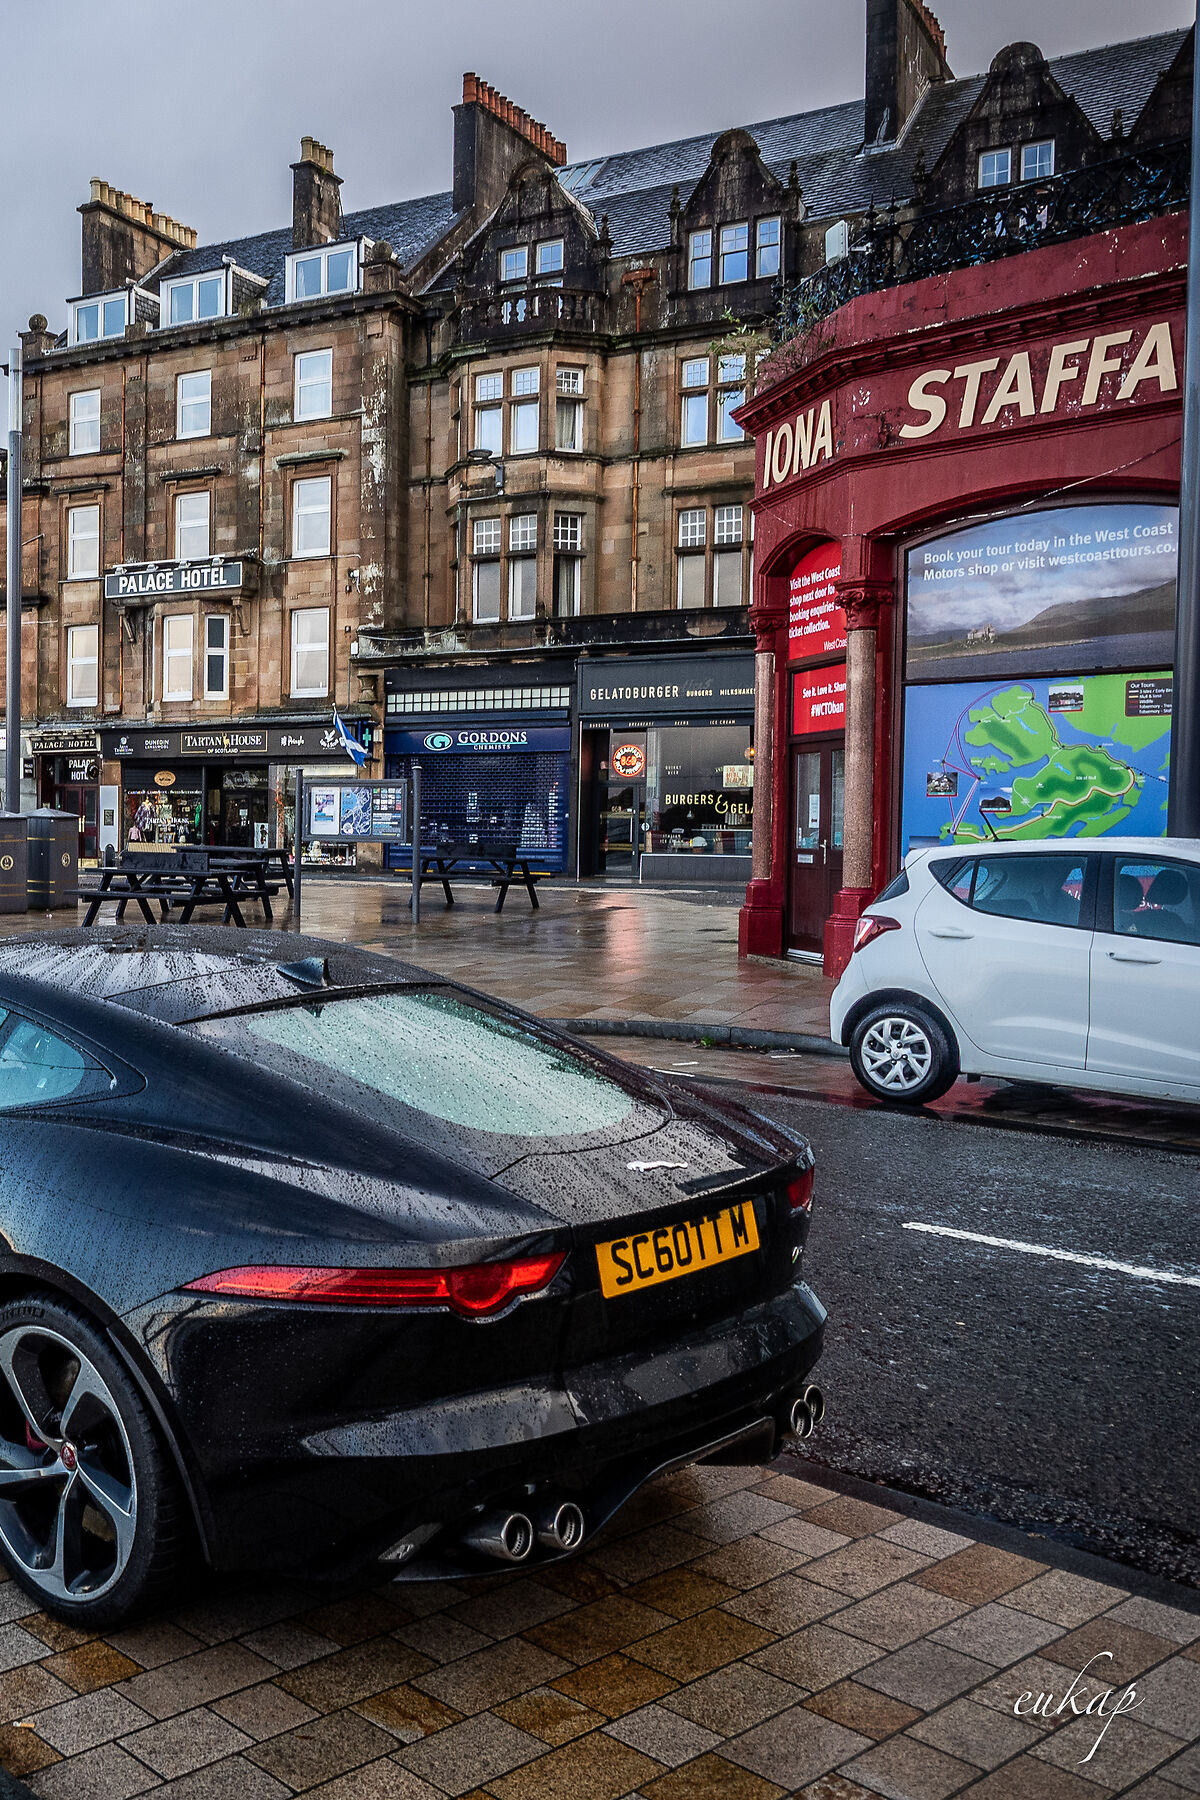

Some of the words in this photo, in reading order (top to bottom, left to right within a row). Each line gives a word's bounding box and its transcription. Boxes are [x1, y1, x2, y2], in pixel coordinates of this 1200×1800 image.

[899, 322, 1178, 439] STAFFA
[763, 399, 834, 489] IONA
[924, 550, 955, 565] Book
[956, 548, 983, 565] your
[986, 545, 1012, 559] tour
[1014, 539, 1050, 556] today
[1053, 536, 1066, 548] in
[1069, 533, 1091, 547] the
[1095, 528, 1129, 544] West
[1133, 522, 1173, 539] Coast
[923, 565, 965, 581] Motors
[967, 562, 998, 577] shop
[1001, 559, 1014, 572] or
[1017, 555, 1045, 571] visit
[1049, 541, 1176, 567] westcoasttours.co.
[118, 571, 174, 594] PALACE
[180, 566, 227, 589] HOTEL
[789, 576, 802, 591] Visit
[802, 574, 811, 587] the
[811, 570, 825, 584] West
[825, 565, 841, 580] Coast
[789, 594, 802, 608] shop
[802, 589, 815, 603] next
[815, 586, 828, 600] door
[789, 608, 810, 623] booking
[810, 601, 835, 618] enquiries
[788, 624, 803, 639] ticket
[803, 619, 831, 637] collection.
[590, 685, 679, 701] GELATOBURGER
[686, 689, 713, 697] BURGERS
[802, 687, 811, 699] See
[817, 685, 828, 696] Love
[833, 681, 847, 693] Shar
[810, 700, 844, 717] #WCTOban
[33, 741, 64, 749] PALACE
[68, 740, 95, 748] HOTEL
[184, 735, 222, 747] TARTAN
[230, 734, 262, 746] HOUSE
[457, 731, 527, 744] GORDONS
[665, 794, 714, 805] BURGERS
[715, 794, 728, 814] &
